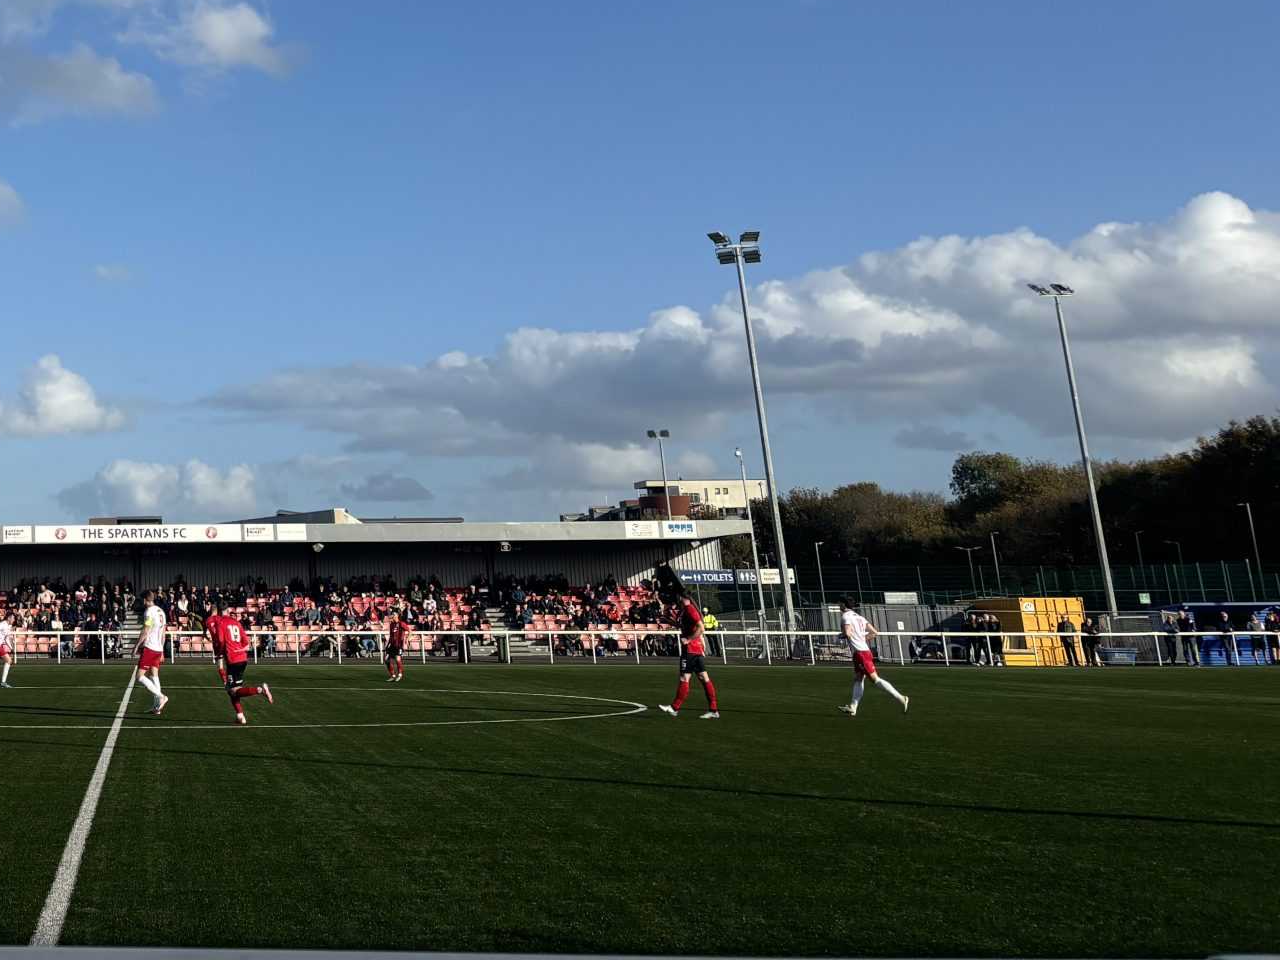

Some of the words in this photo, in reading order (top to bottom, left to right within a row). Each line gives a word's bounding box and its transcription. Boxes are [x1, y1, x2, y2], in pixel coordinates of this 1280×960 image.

[81, 527, 104, 539] THE
[107, 528, 169, 539] SPARTANS
[173, 527, 187, 539] FC
[703, 573, 734, 582] TOILETS
[227, 624, 240, 642] 19
